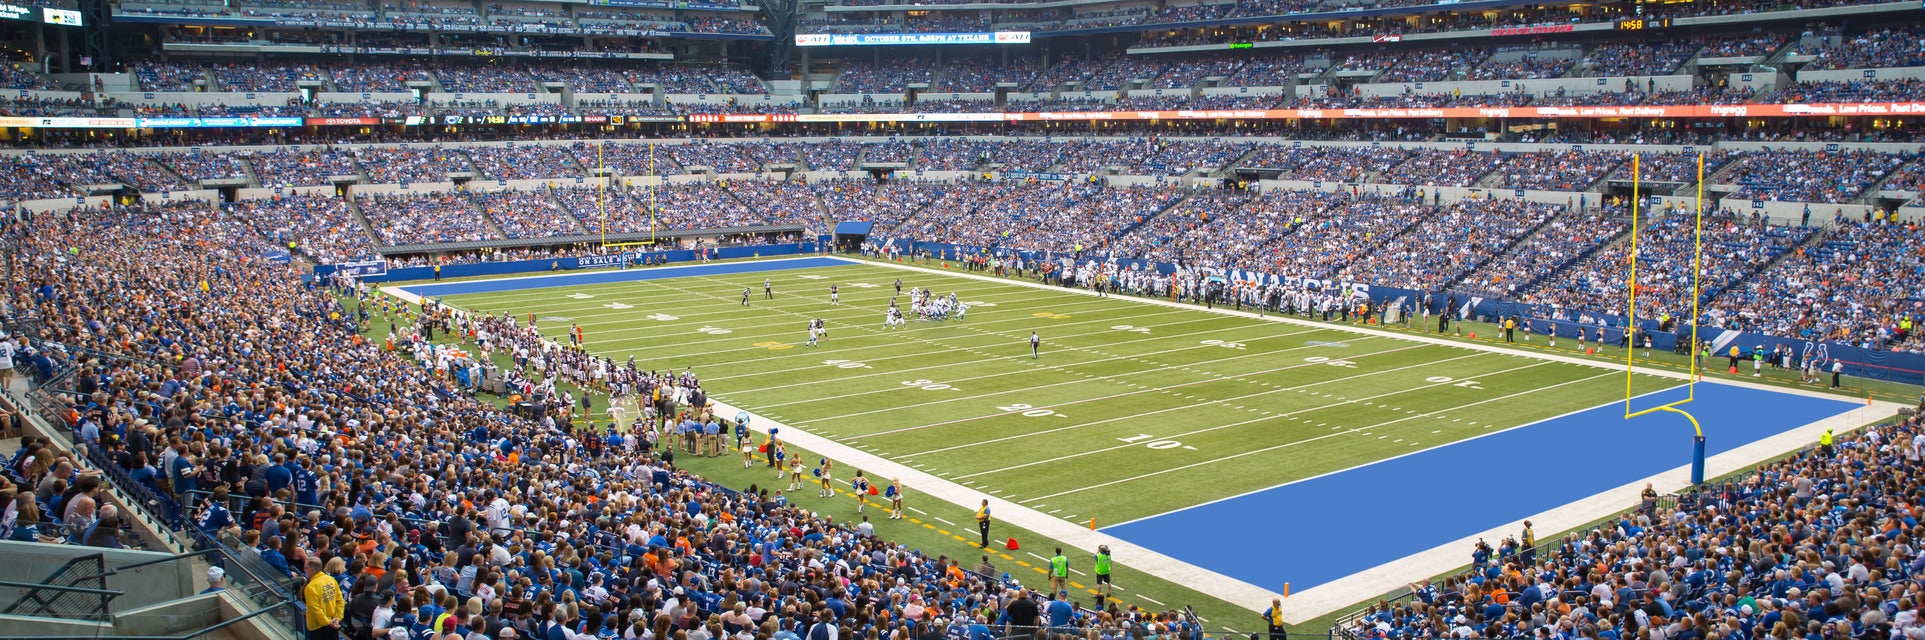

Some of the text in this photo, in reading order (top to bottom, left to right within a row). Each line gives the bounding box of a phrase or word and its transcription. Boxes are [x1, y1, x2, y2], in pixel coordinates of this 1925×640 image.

[1620, 20, 1642, 30] 14:58
[1664, 18, 1668, 27] 1
[1491, 28, 1516, 36] LUCAS
[1533, 25, 1573, 33] STADIUM
[864, 35, 900, 43] OCTOBER
[957, 34, 989, 42] TEXANS
[1479, 108, 1509, 117] hhgregg
[1635, 107, 1665, 116] Delivery
[1711, 106, 1747, 116] hhgregg
[1891, 103, 1910, 112] Fast
[593, 256, 613, 264] SALE
[901, 379, 952, 391] 30
[995, 403, 1055, 417] 20
[1116, 433, 1182, 449] 10
[297, 479, 307, 491] 12
[500, 508, 508, 520] 12
